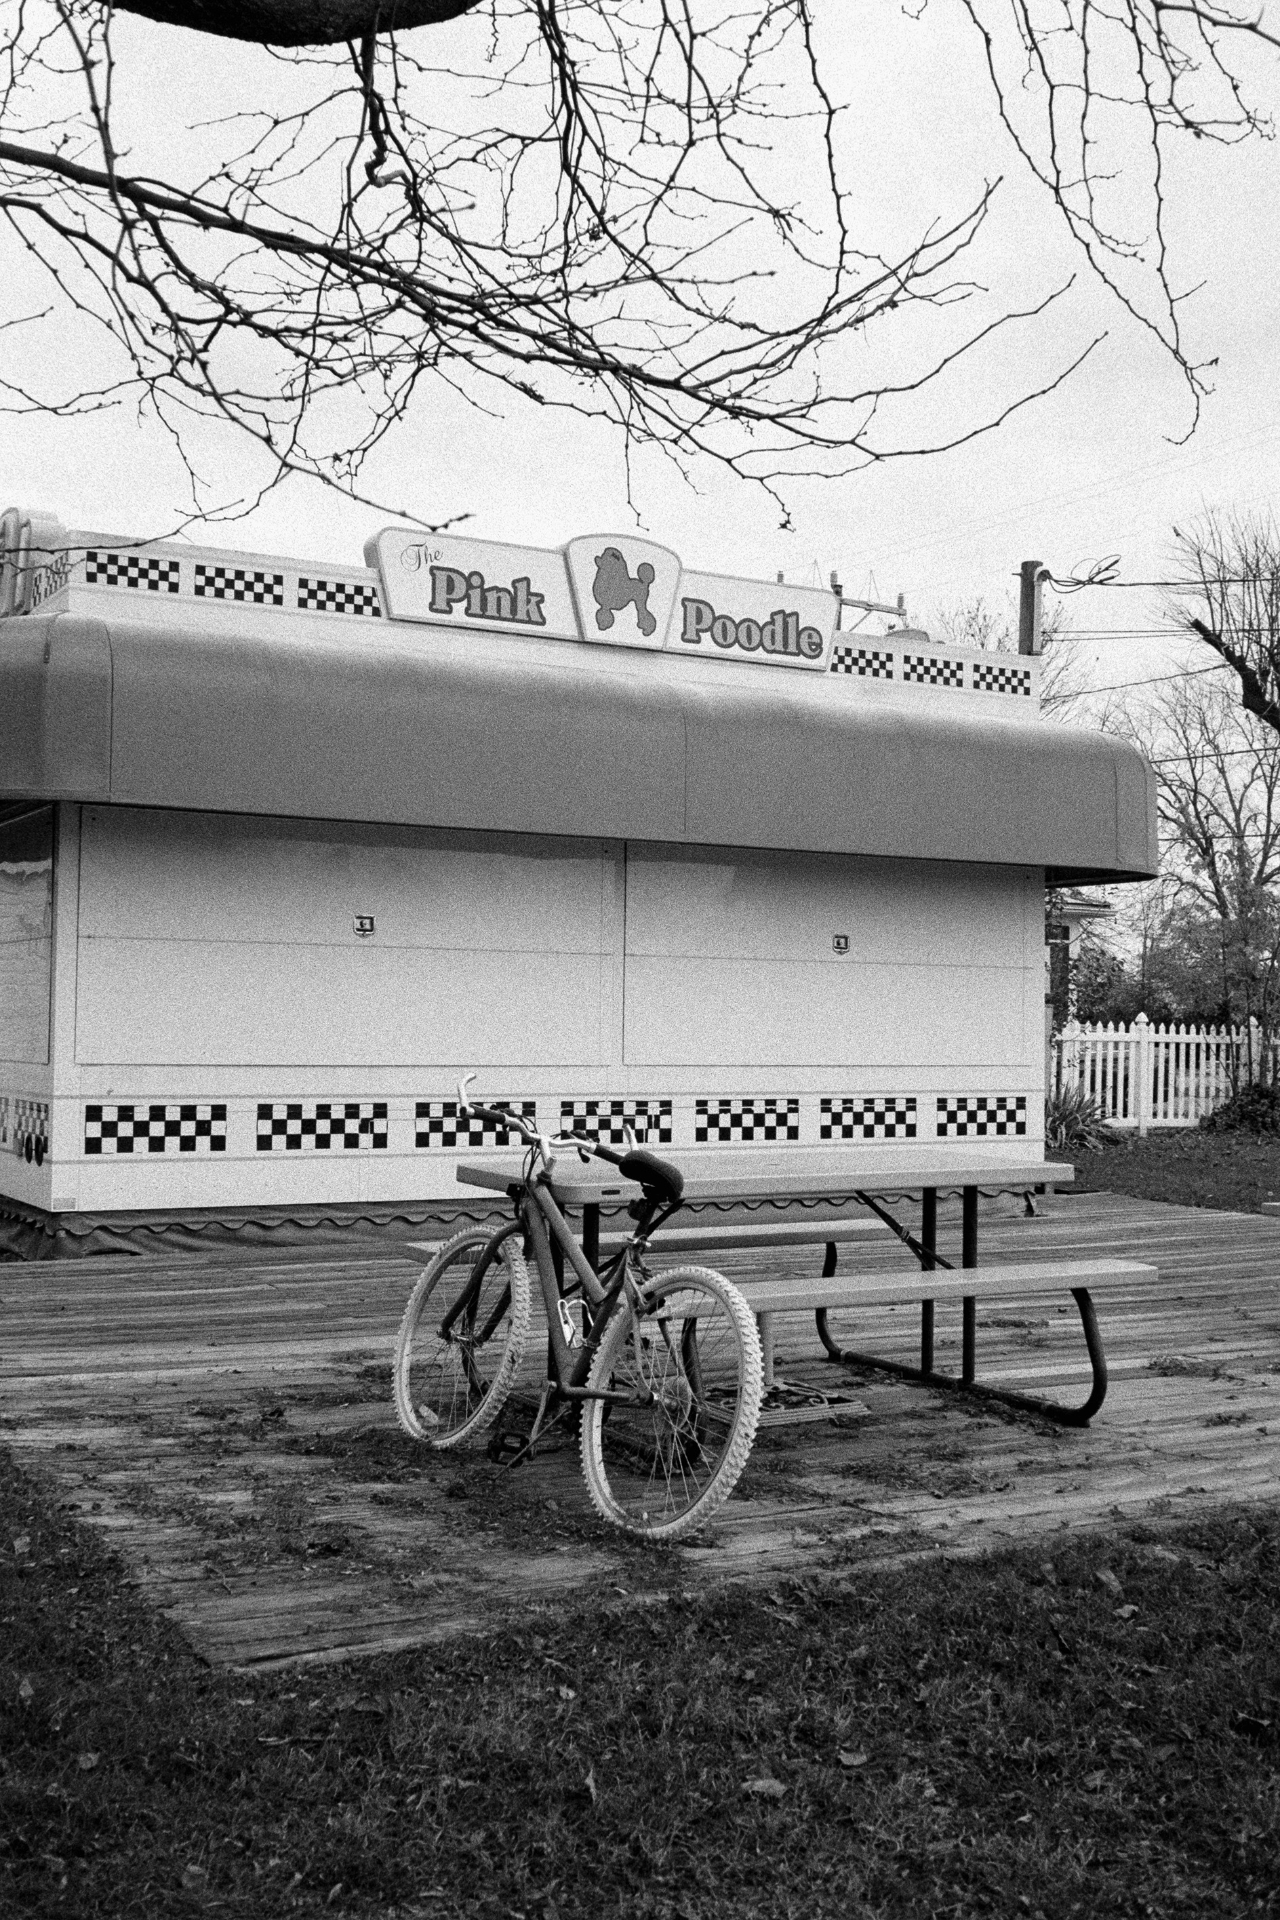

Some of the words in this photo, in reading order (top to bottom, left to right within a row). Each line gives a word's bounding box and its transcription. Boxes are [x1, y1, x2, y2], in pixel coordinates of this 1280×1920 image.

[400, 544, 443, 573] The
[429, 567, 546, 625] Pink
[682, 598, 823, 659] Poodle
